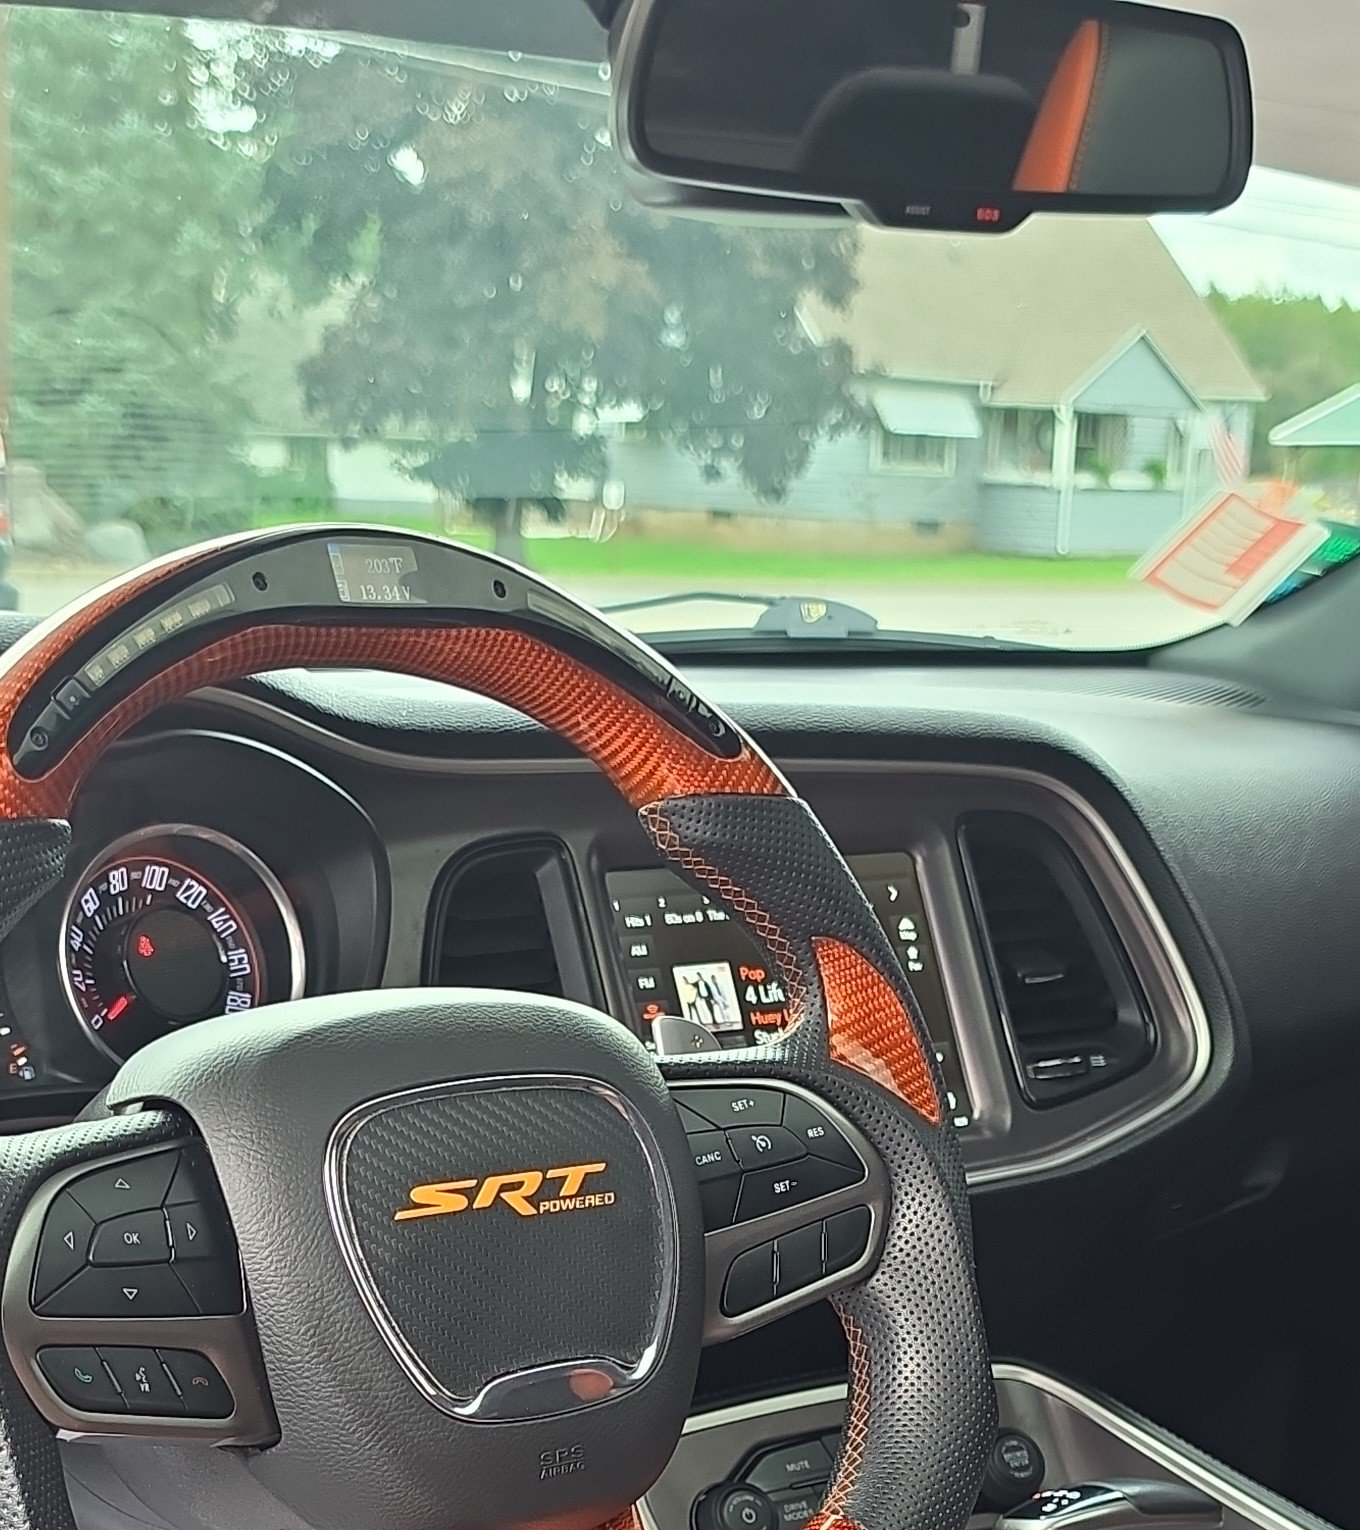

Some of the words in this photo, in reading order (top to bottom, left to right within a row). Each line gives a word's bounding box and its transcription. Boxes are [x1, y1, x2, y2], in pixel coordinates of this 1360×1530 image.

[108, 867, 128, 895] 80
[141, 865, 170, 892] 100
[175, 877, 208, 910] 120
[207, 907, 238, 939] 140
[739, 966, 766, 982] Pop
[745, 984, 758, 1004] 4
[749, 1011, 782, 1026] Huey
[807, 1126, 825, 1138] RES
[695, 1151, 722, 1166] CANC
[393, 1162, 607, 1221] SRT
[539, 1191, 616, 1215] POWERED
[123, 1231, 141, 1245] OK
[785, 1459, 811, 1473] MUTE
